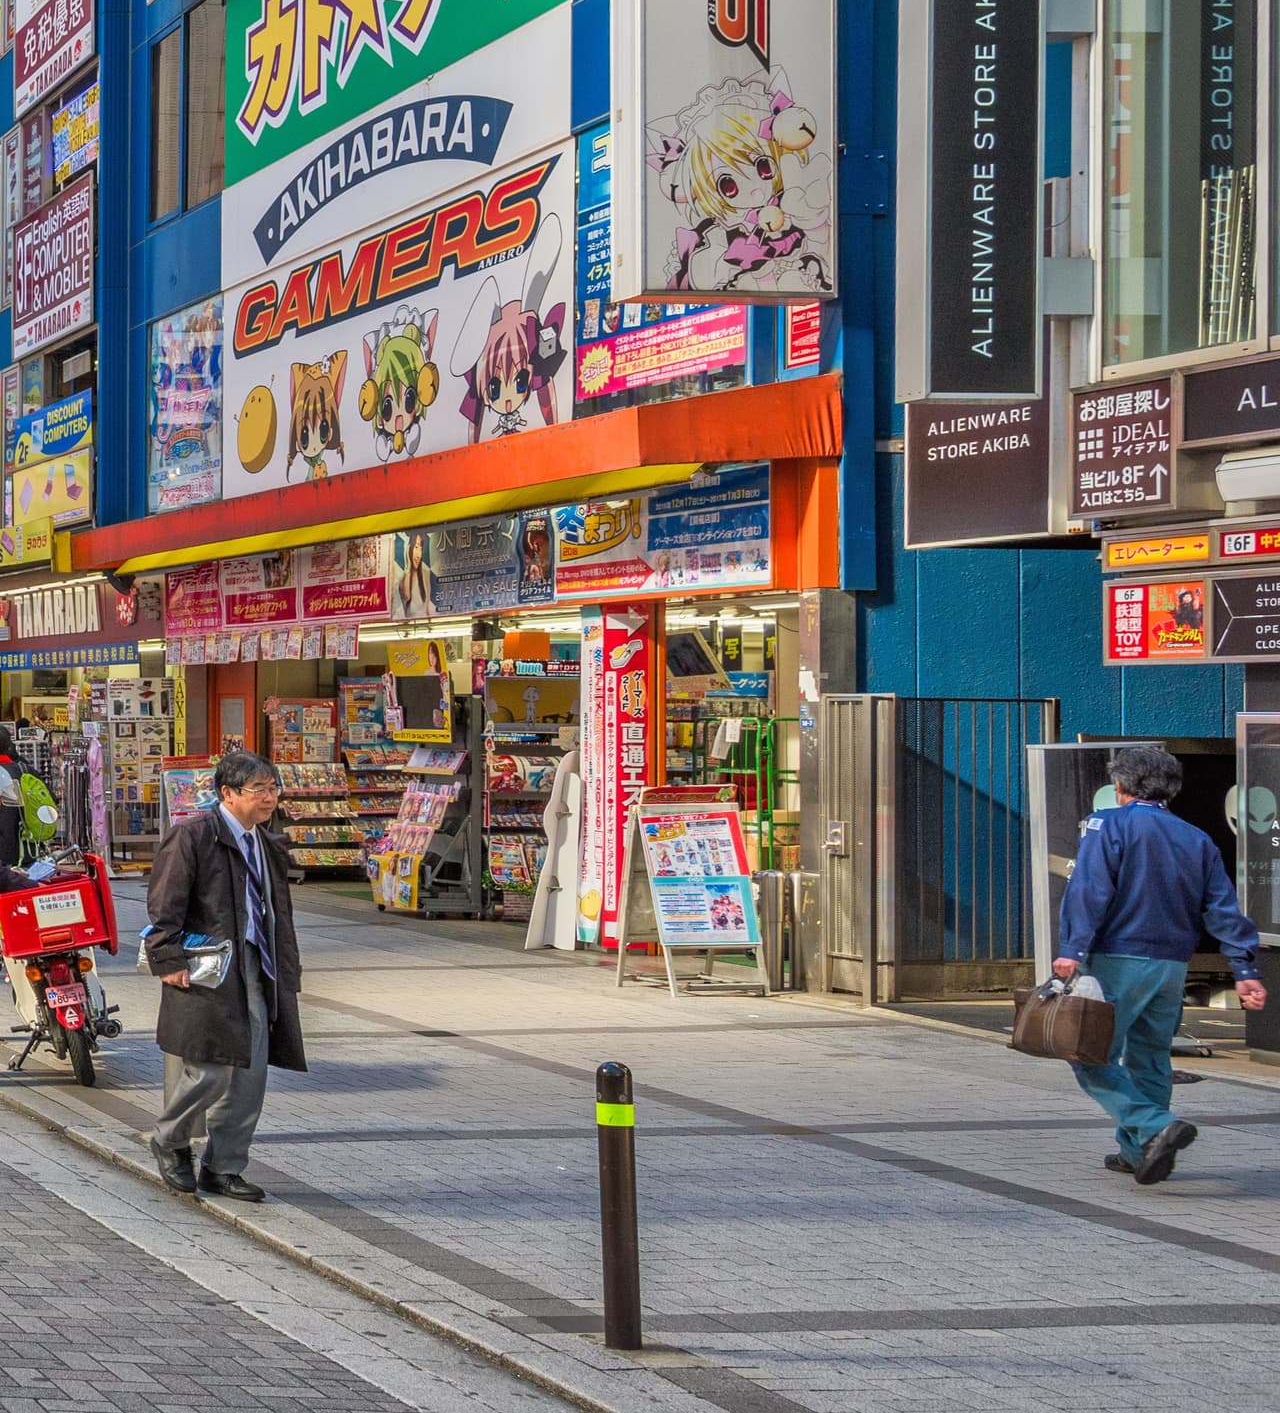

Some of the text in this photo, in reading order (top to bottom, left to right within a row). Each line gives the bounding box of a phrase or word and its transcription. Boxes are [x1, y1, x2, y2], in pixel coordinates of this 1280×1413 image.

[35, 46, 73, 99] TAKARADA
[973, 41, 997, 151] STORE
[273, 98, 477, 238] AKIHABARA
[33, 211, 63, 244] English
[32, 224, 90, 283] COMPUTER
[234, 155, 560, 358] GAMERS
[477, 243, 525, 270] ANIBRO
[970, 162, 994, 360] ALIENWARE
[16, 232, 33, 318] 3F
[32, 264, 90, 310] & MOBILE
[34, 305, 73, 344] TAKARADA
[46, 398, 84, 425] DISCOUNT
[1078, 388, 1171, 423] お部屋探し
[43, 414, 88, 443] COMPUTERS
[927, 406, 1033, 437] ALIENWARE
[1111, 419, 1170, 444] iDEAL
[927, 432, 1031, 461] STORE AKIBA
[1111, 441, 1170, 459] アイデアル
[1079, 464, 1145, 490] 当ビル 8F
[1079, 486, 1145, 509] 入口はこちら
[1113, 545, 1186, 562] エレベーター
[1233, 534, 1251, 552] 6F
[1123, 589, 1136, 601] 6F
[14, 584, 100, 638] TAKARADA
[1114, 603, 1143, 618] 鉄道
[1114, 617, 1143, 632] 模型
[1115, 632, 1142, 647] TOY
